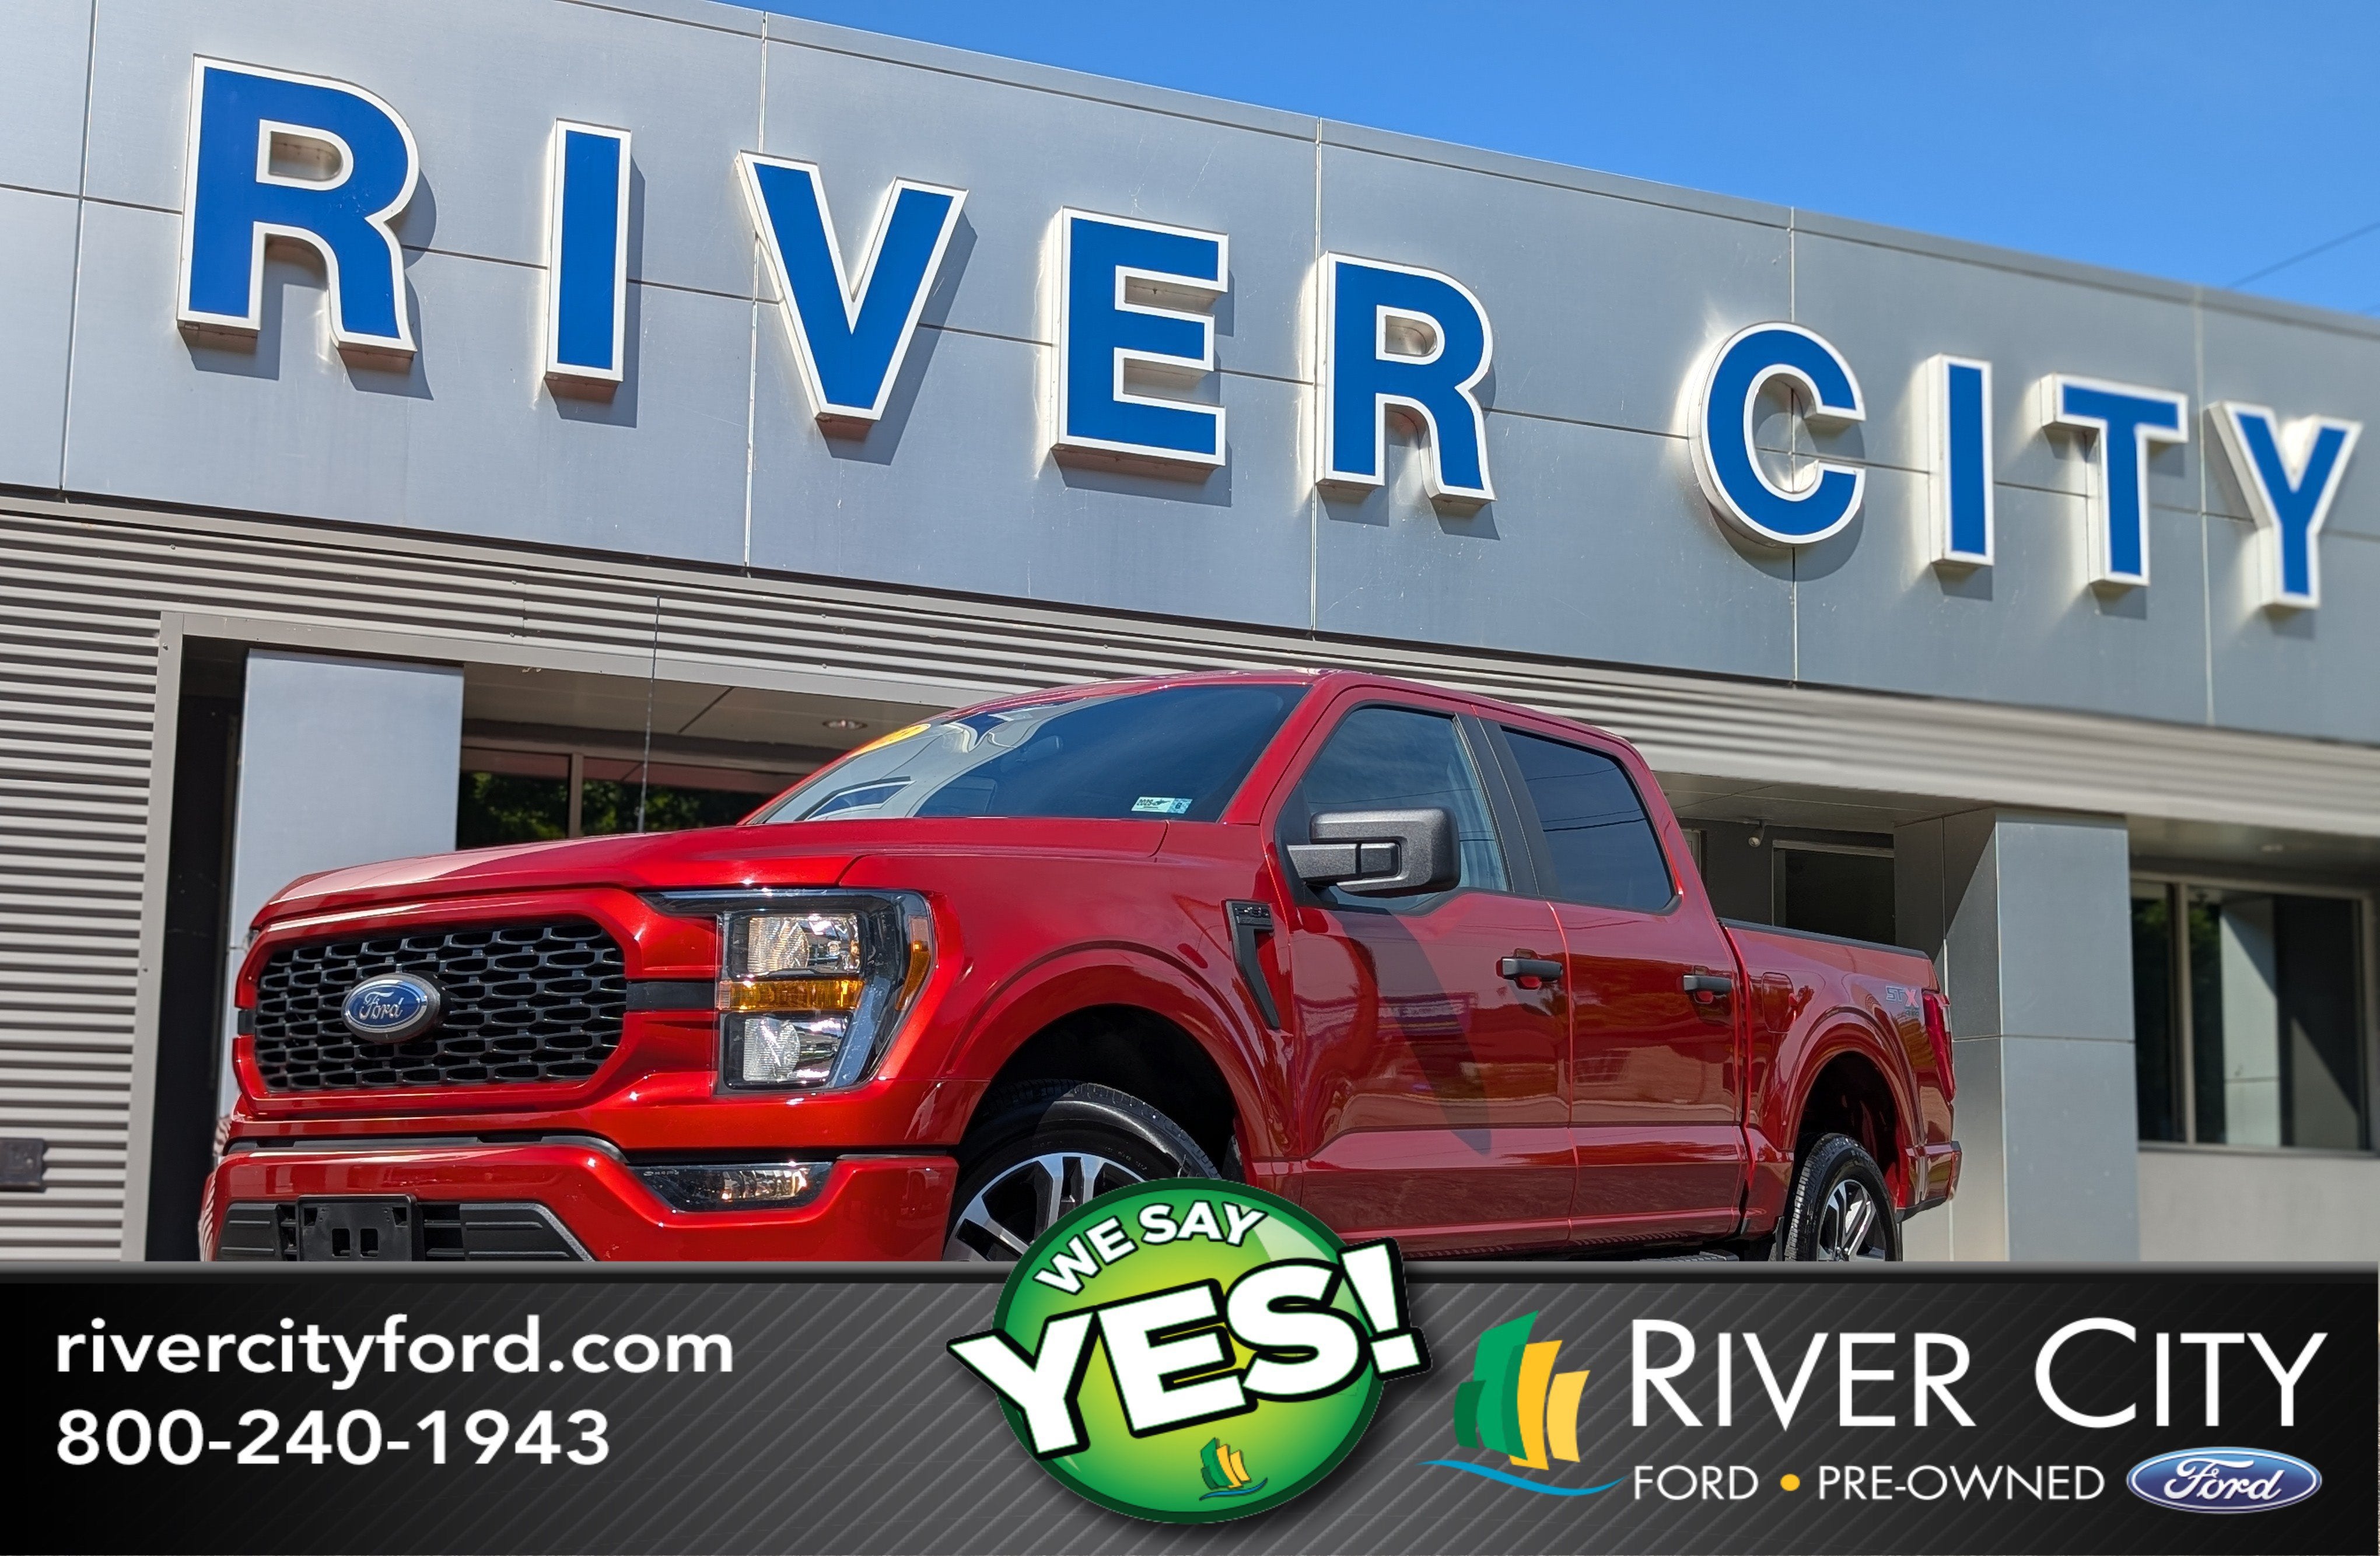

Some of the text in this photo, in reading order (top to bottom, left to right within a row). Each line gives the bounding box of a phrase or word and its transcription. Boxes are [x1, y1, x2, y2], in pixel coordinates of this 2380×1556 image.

[177, 54, 2362, 608] RIVER CITY
[359, 991, 404, 1019] Ford
[1885, 986, 1919, 1008] STX
